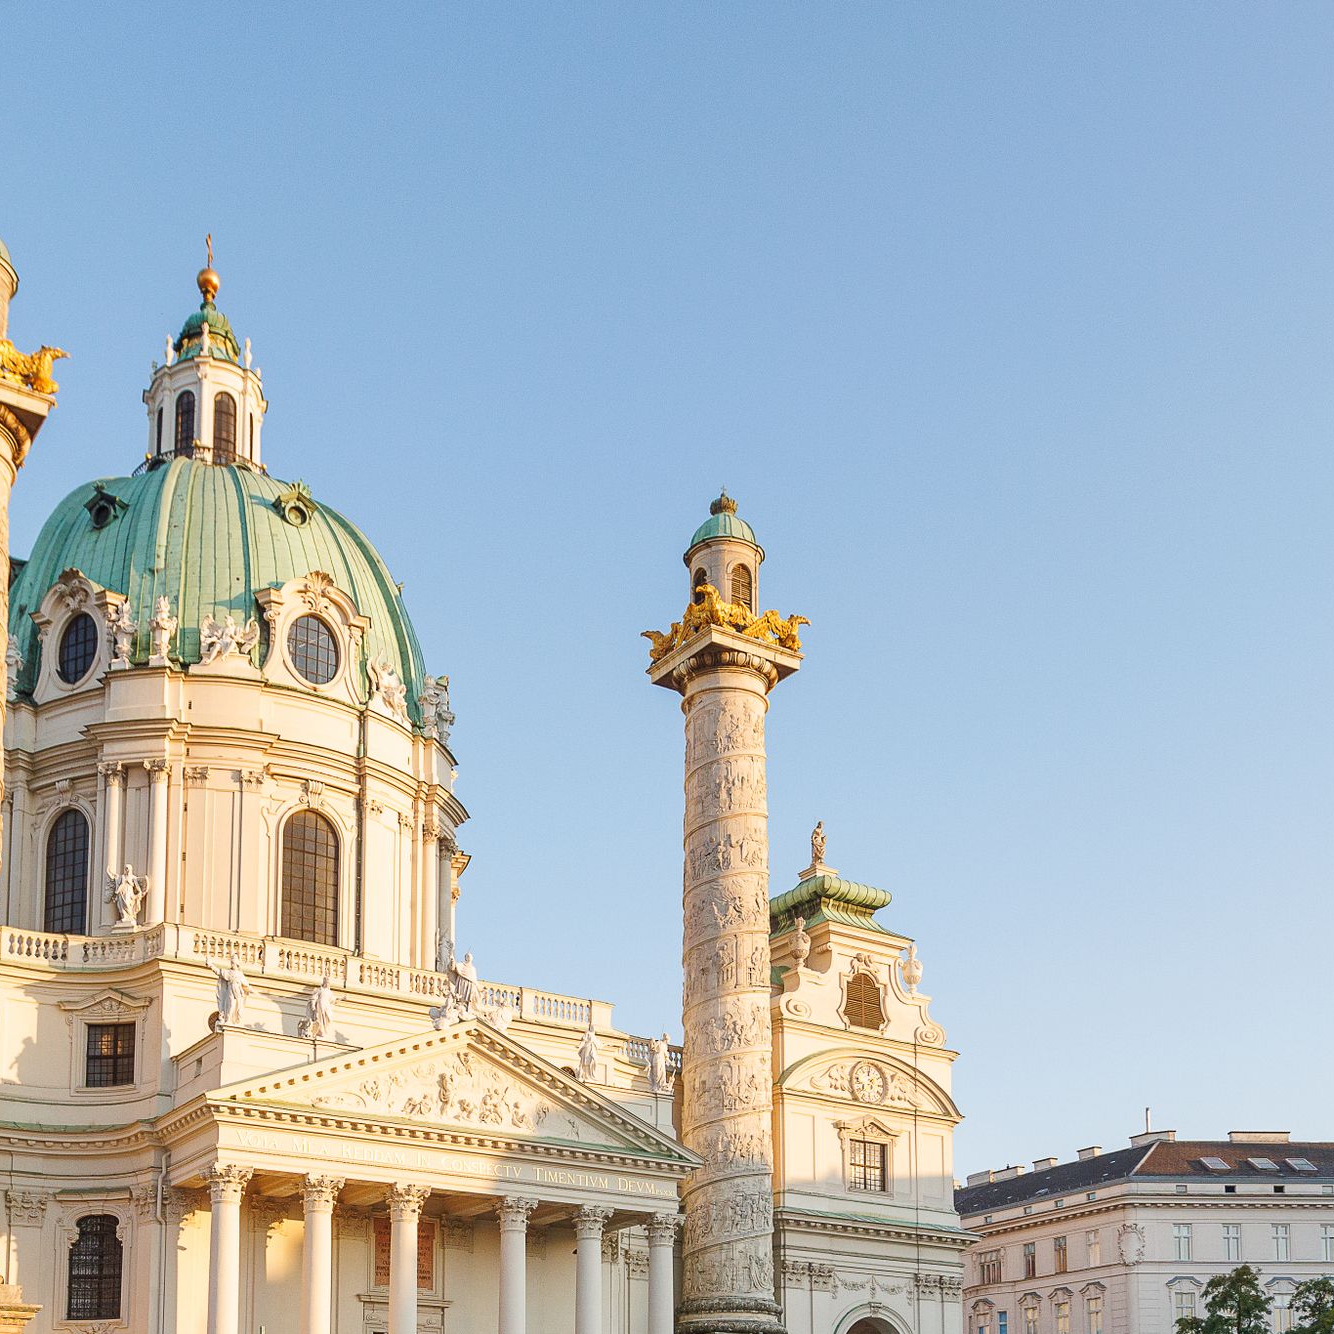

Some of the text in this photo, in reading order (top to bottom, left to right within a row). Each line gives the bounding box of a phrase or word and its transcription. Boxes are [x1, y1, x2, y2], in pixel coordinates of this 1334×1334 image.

[441, 1156, 522, 1177] CONSPECTV
[533, 1166, 608, 1189] TIMENTIVM
[618, 1177, 655, 1195] DEVM
